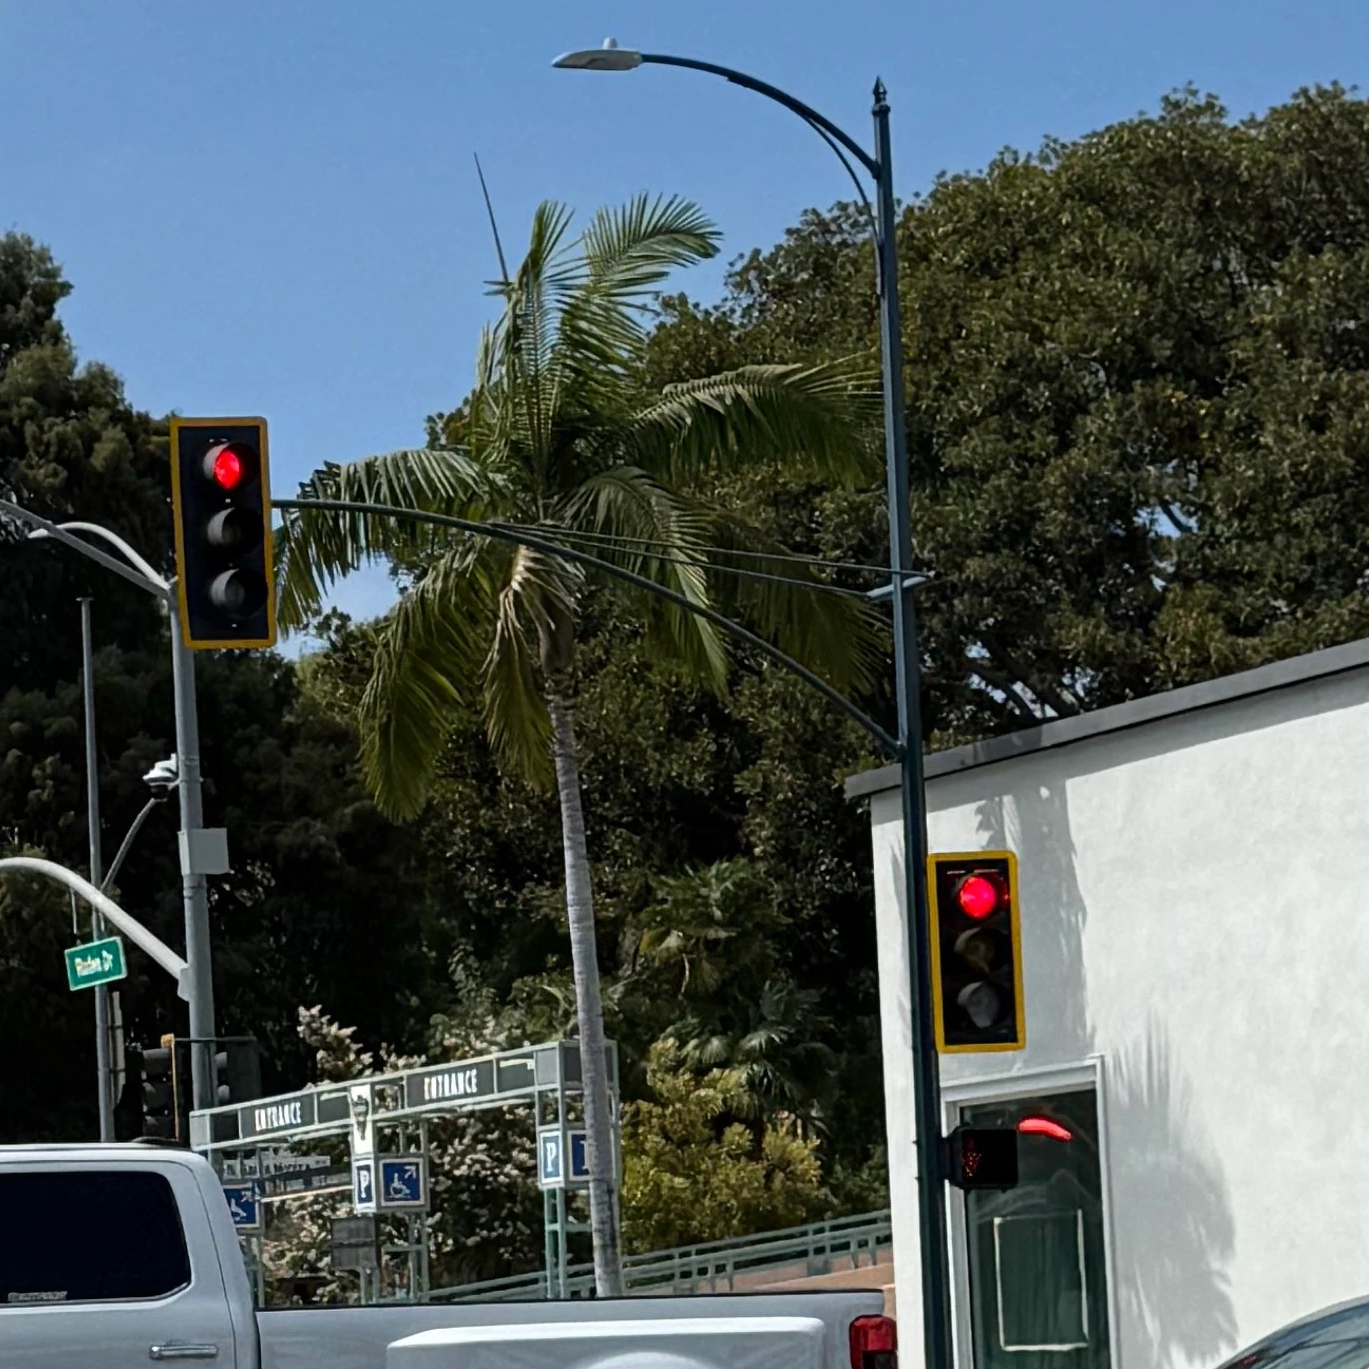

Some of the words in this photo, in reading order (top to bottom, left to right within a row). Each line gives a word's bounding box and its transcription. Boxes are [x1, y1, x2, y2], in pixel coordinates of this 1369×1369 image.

[424, 1068, 478, 1100] ENTRANCE
[254, 1102, 301, 1131] ENTRANCE
[545, 1142, 557, 1172] P
[359, 1169, 370, 1199] P
